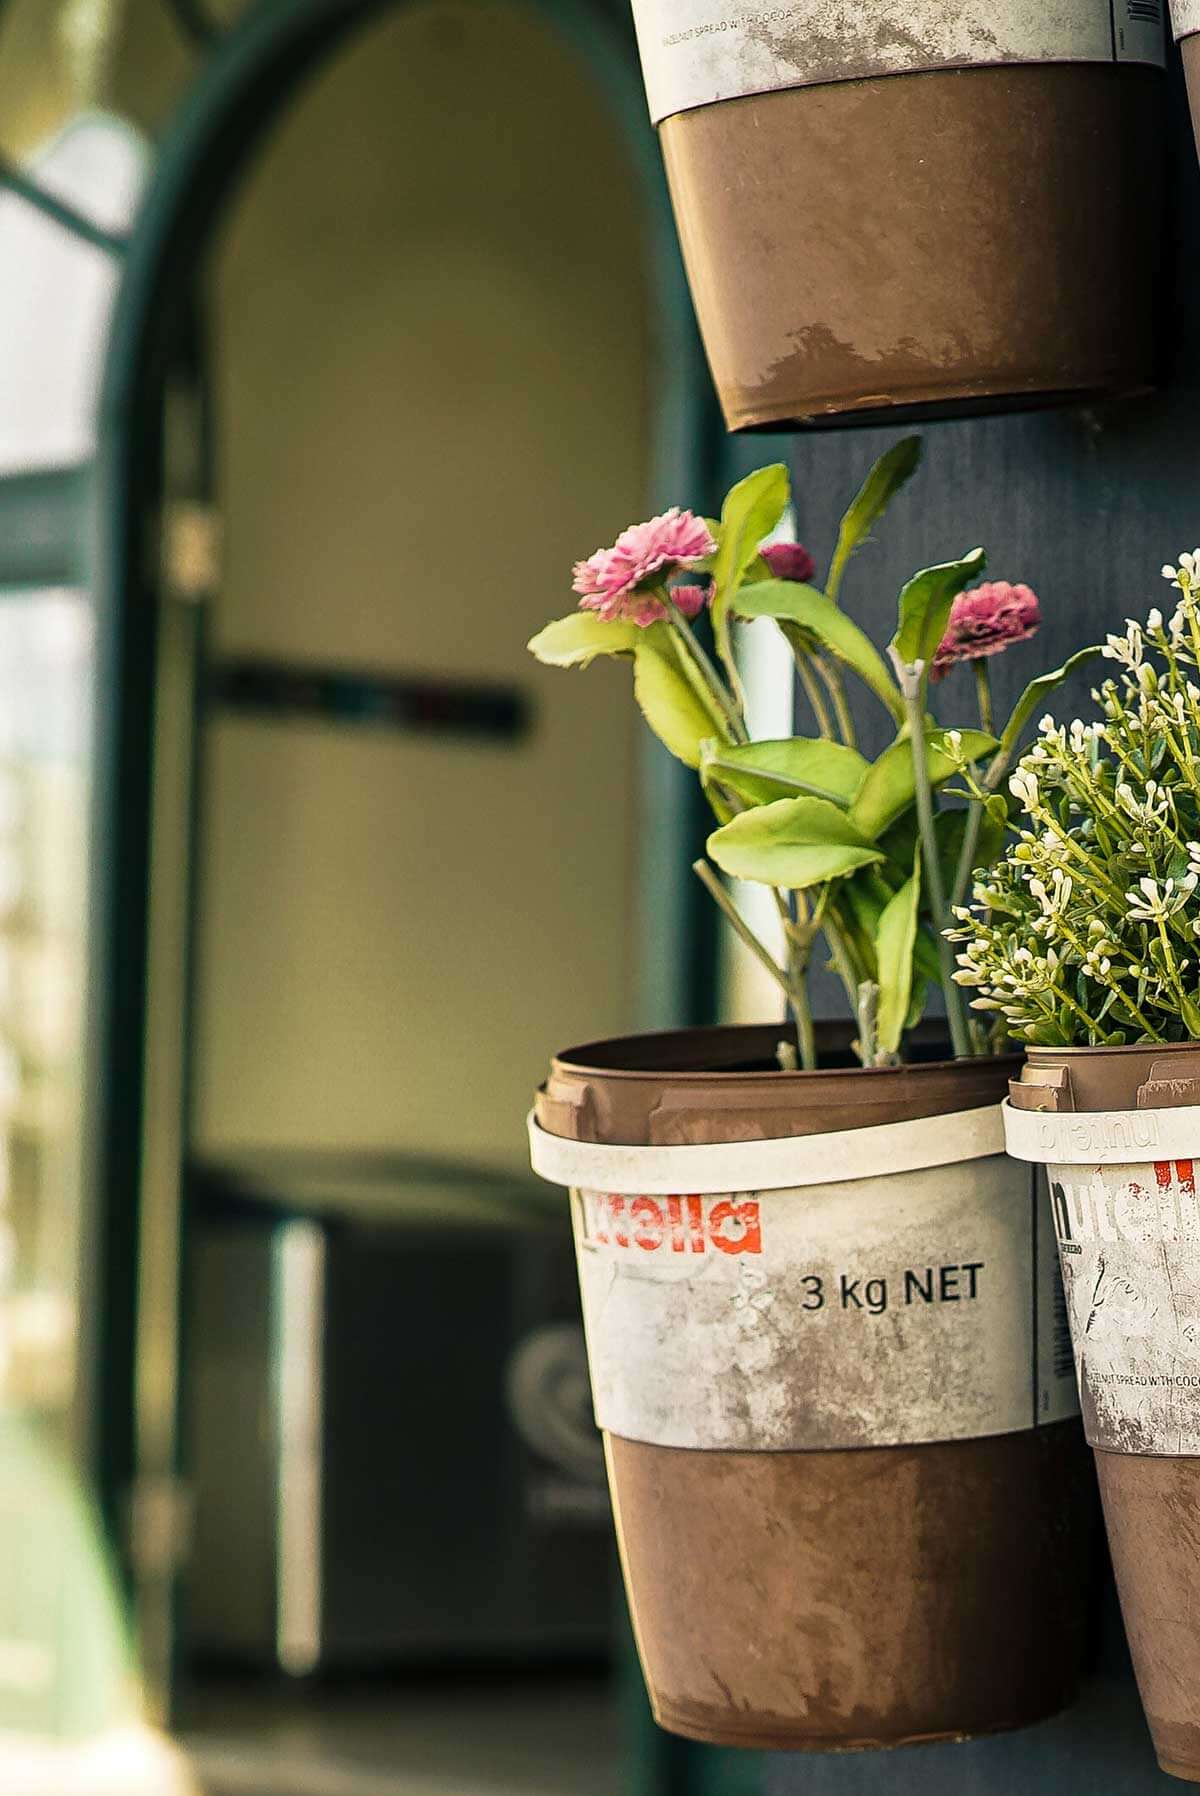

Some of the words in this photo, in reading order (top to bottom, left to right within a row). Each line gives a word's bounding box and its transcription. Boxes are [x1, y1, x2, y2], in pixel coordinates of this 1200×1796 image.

[800, 1274, 825, 1311] 3
[839, 1274, 887, 1316] kg
[903, 1261, 986, 1306] NET
